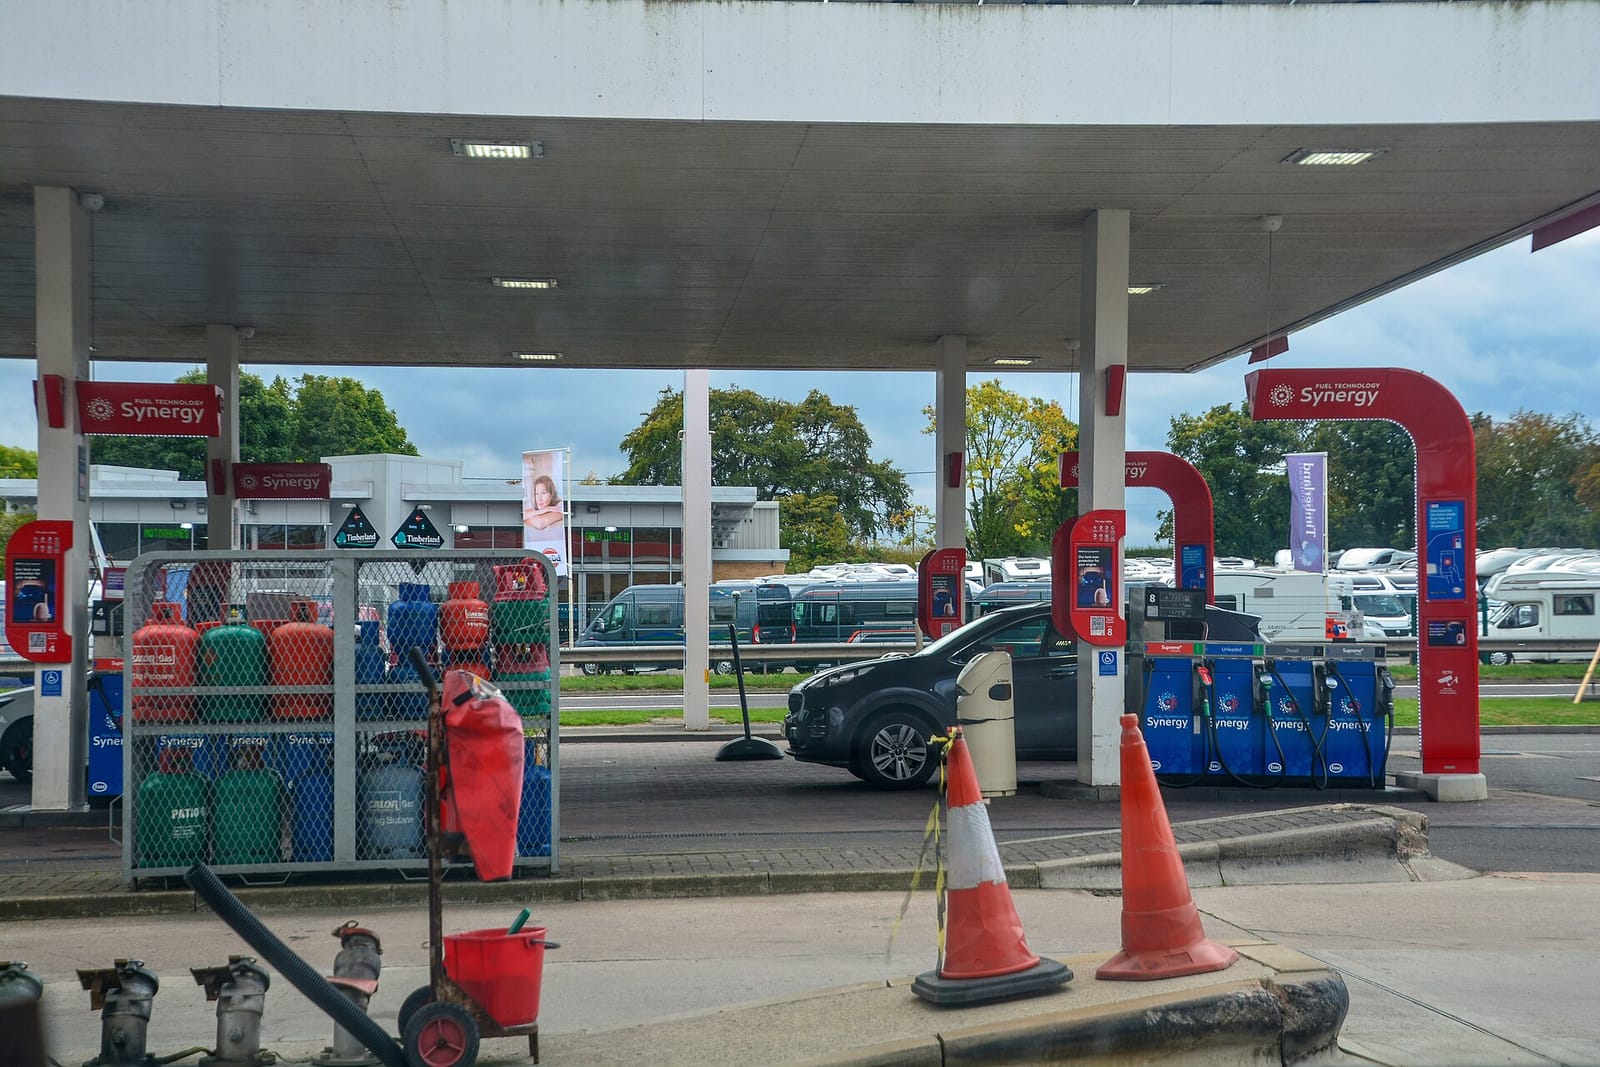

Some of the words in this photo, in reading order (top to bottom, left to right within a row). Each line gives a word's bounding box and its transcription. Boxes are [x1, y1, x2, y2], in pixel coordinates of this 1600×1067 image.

[1300, 387, 1379, 407] Synergy
[120, 401, 205, 423] Synergy
[263, 476, 320, 490] Synergy
[346, 532, 376, 542] Timberland
[407, 534, 440, 543] Timberland
[1149, 593, 1156, 603] 8
[96, 607, 104, 617] 4
[1107, 628, 1113, 636] 8
[48, 645, 56, 653] 4
[1147, 717, 1188, 729] Synergy
[93, 736, 123, 748] Syner
[160, 736, 204, 748] Synergy
[226, 737, 270, 748] ynergy
[171, 807, 200, 819] PATIO
